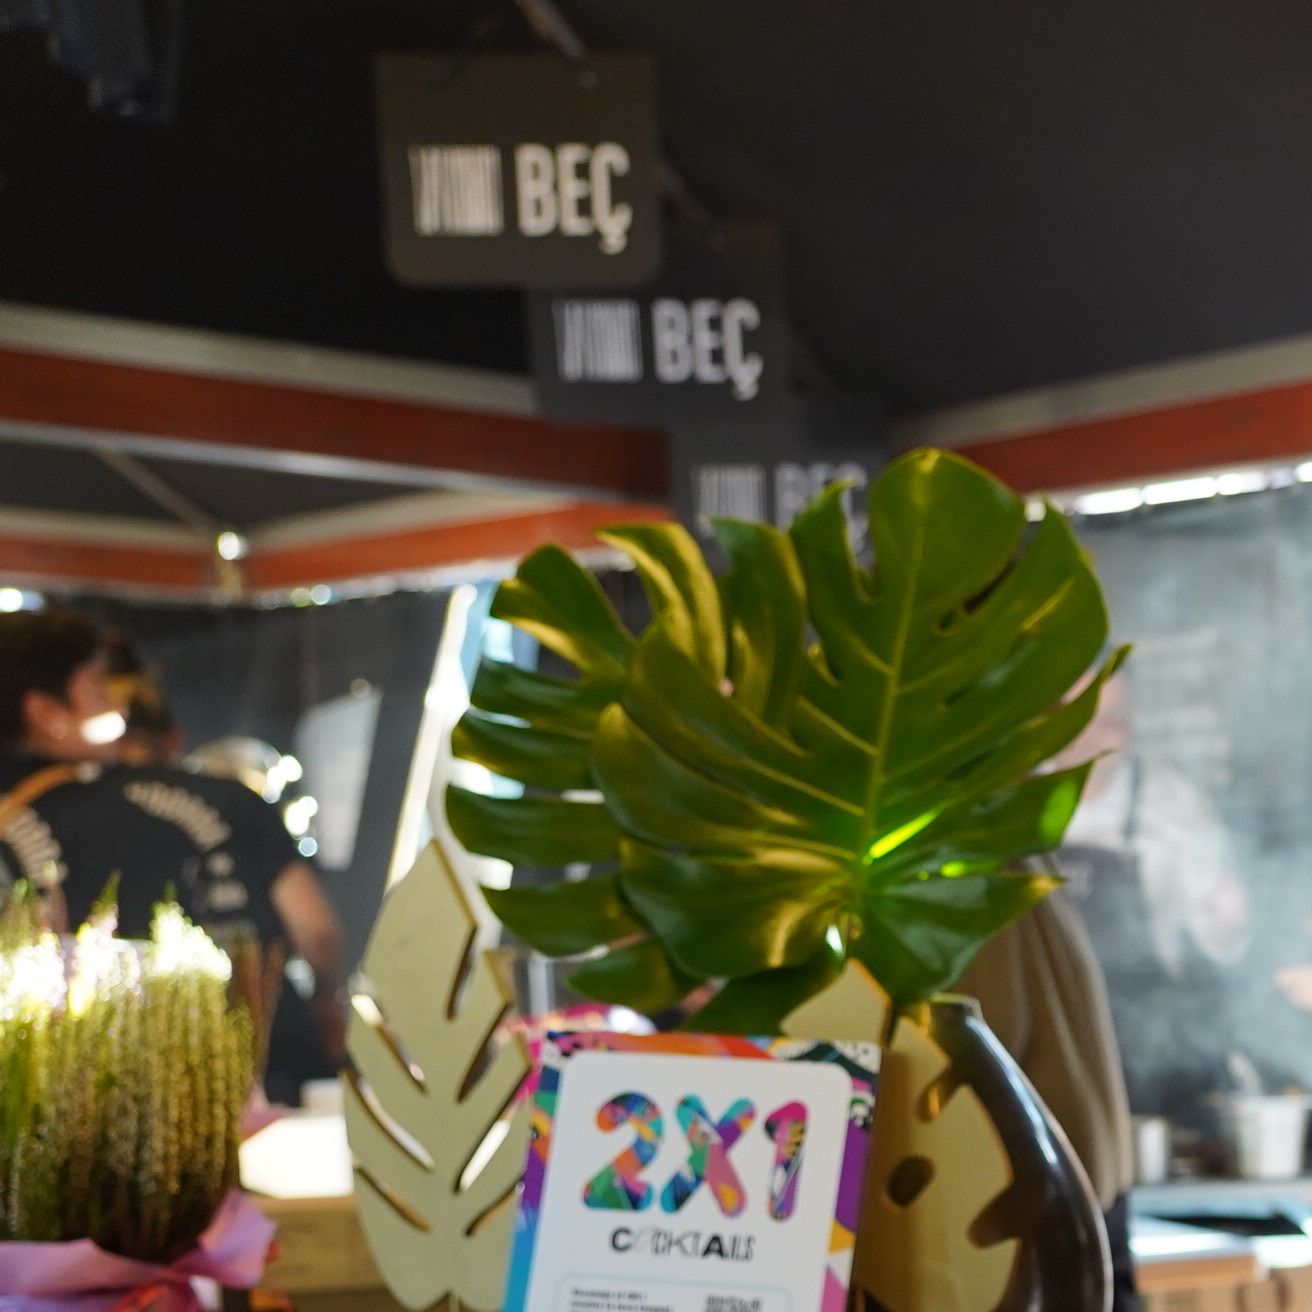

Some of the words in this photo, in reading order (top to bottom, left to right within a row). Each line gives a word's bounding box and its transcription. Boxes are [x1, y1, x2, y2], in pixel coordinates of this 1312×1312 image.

[514, 141, 633, 255] BEÇ
[651, 297, 765, 400] BEÇ
[583, 1089, 808, 1223] 2X1
